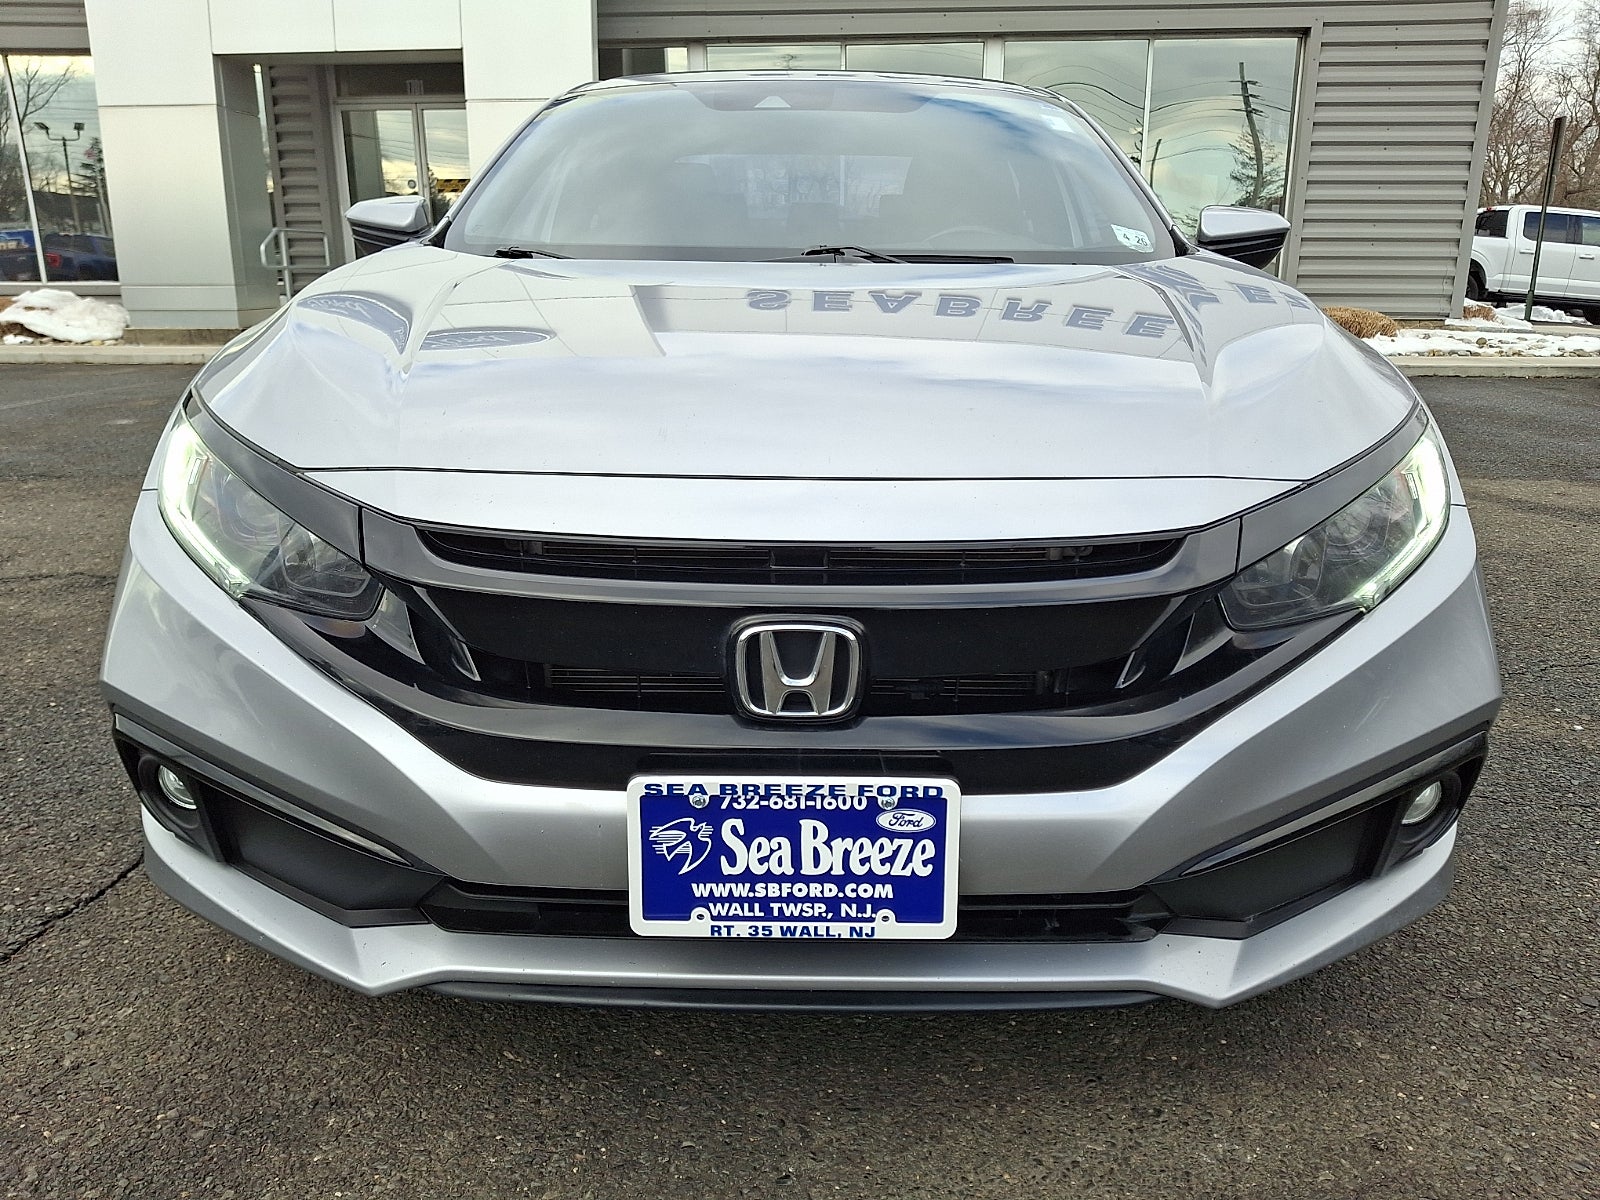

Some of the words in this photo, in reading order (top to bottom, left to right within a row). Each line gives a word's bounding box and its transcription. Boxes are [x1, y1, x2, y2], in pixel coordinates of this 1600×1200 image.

[643, 783, 709, 796] SEA
[719, 783, 847, 797] BREEZE
[857, 784, 944, 798] FORD
[720, 795, 868, 811] 732-681-1600
[888, 812, 925, 828] Ford
[720, 818, 795, 876] Sea
[799, 818, 936, 877] Breeze
[691, 882, 894, 899] WWW.SBFORD.COM
[708, 902, 765, 917] WALL
[840, 903, 877, 918] N.J.
[710, 925, 741, 937] RT.
[747, 925, 773, 937] 35
[779, 926, 842, 938] WALL,
[850, 926, 876, 938] NJ
